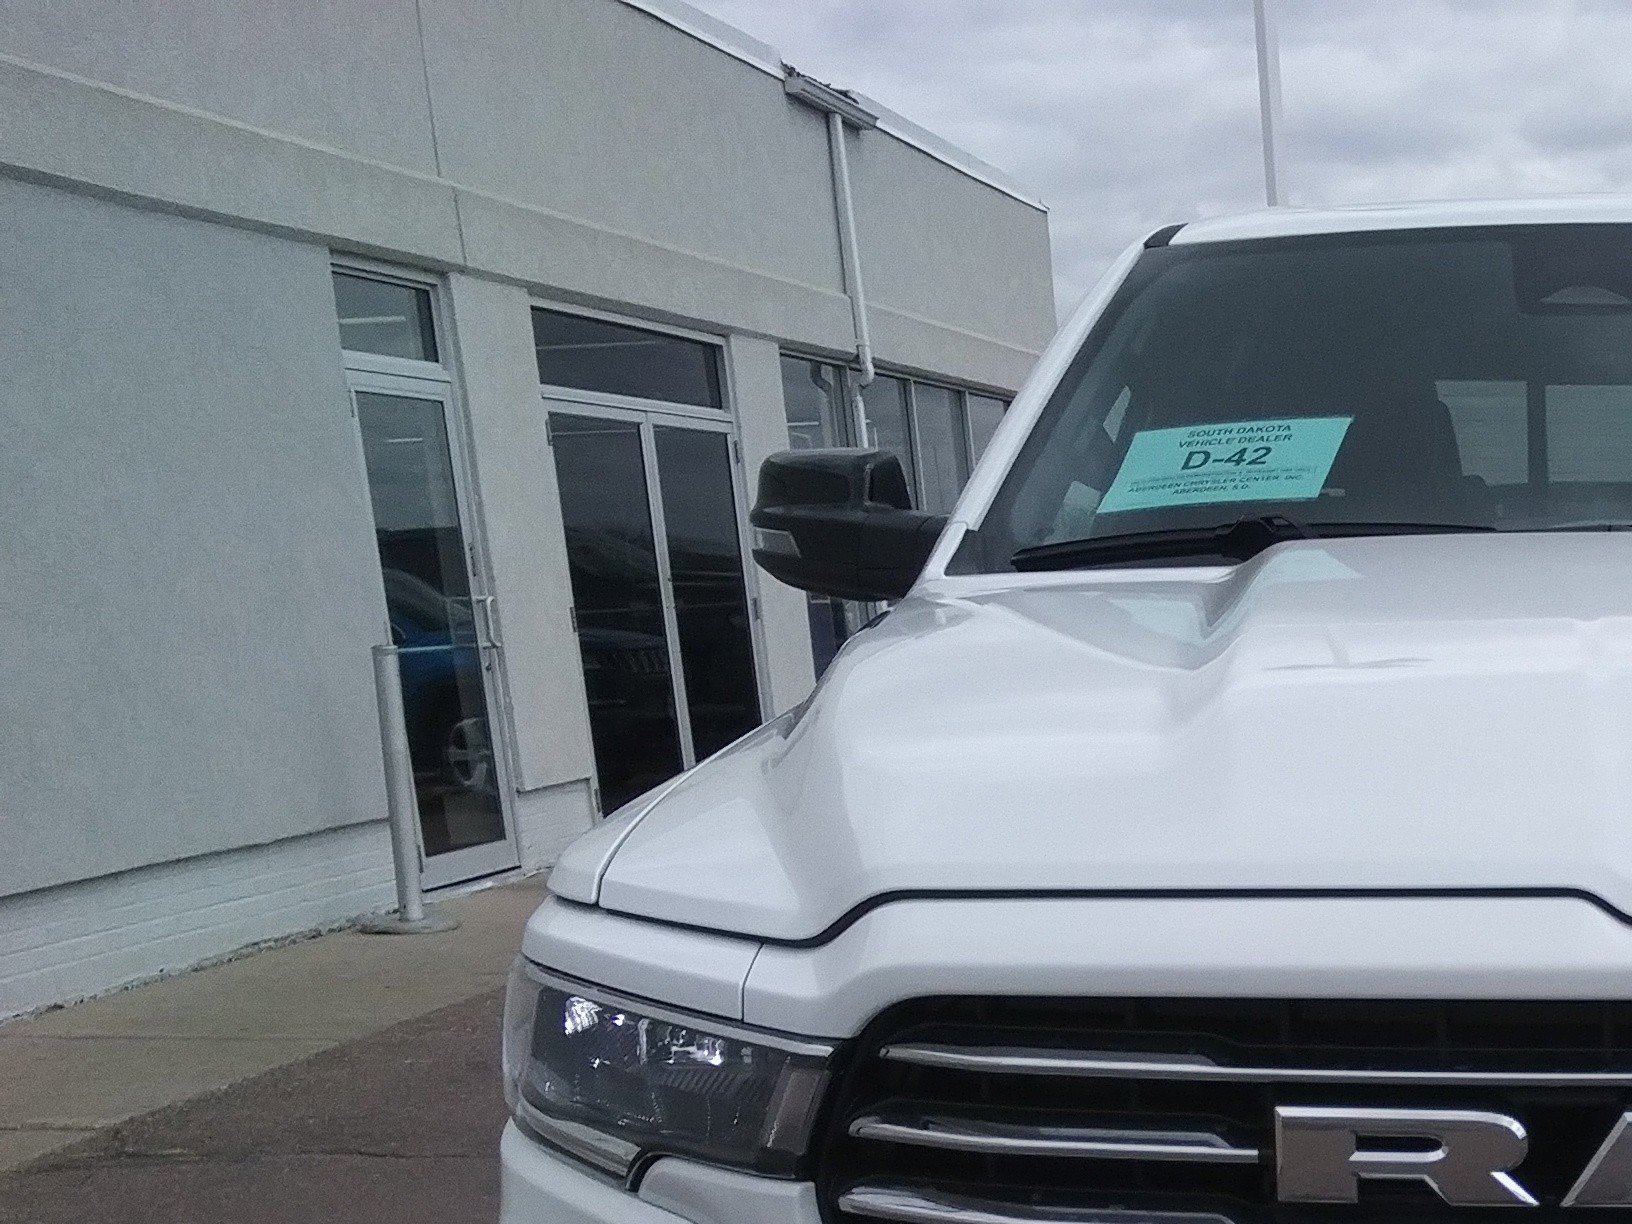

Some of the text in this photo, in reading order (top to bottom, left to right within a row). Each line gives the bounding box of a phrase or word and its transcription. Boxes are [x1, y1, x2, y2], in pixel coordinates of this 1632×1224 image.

[1187, 424, 1292, 439] SOUTH DAKOTA
[1178, 434, 1293, 448] VEHICLE DEALER
[1181, 446, 1273, 471] D-42
